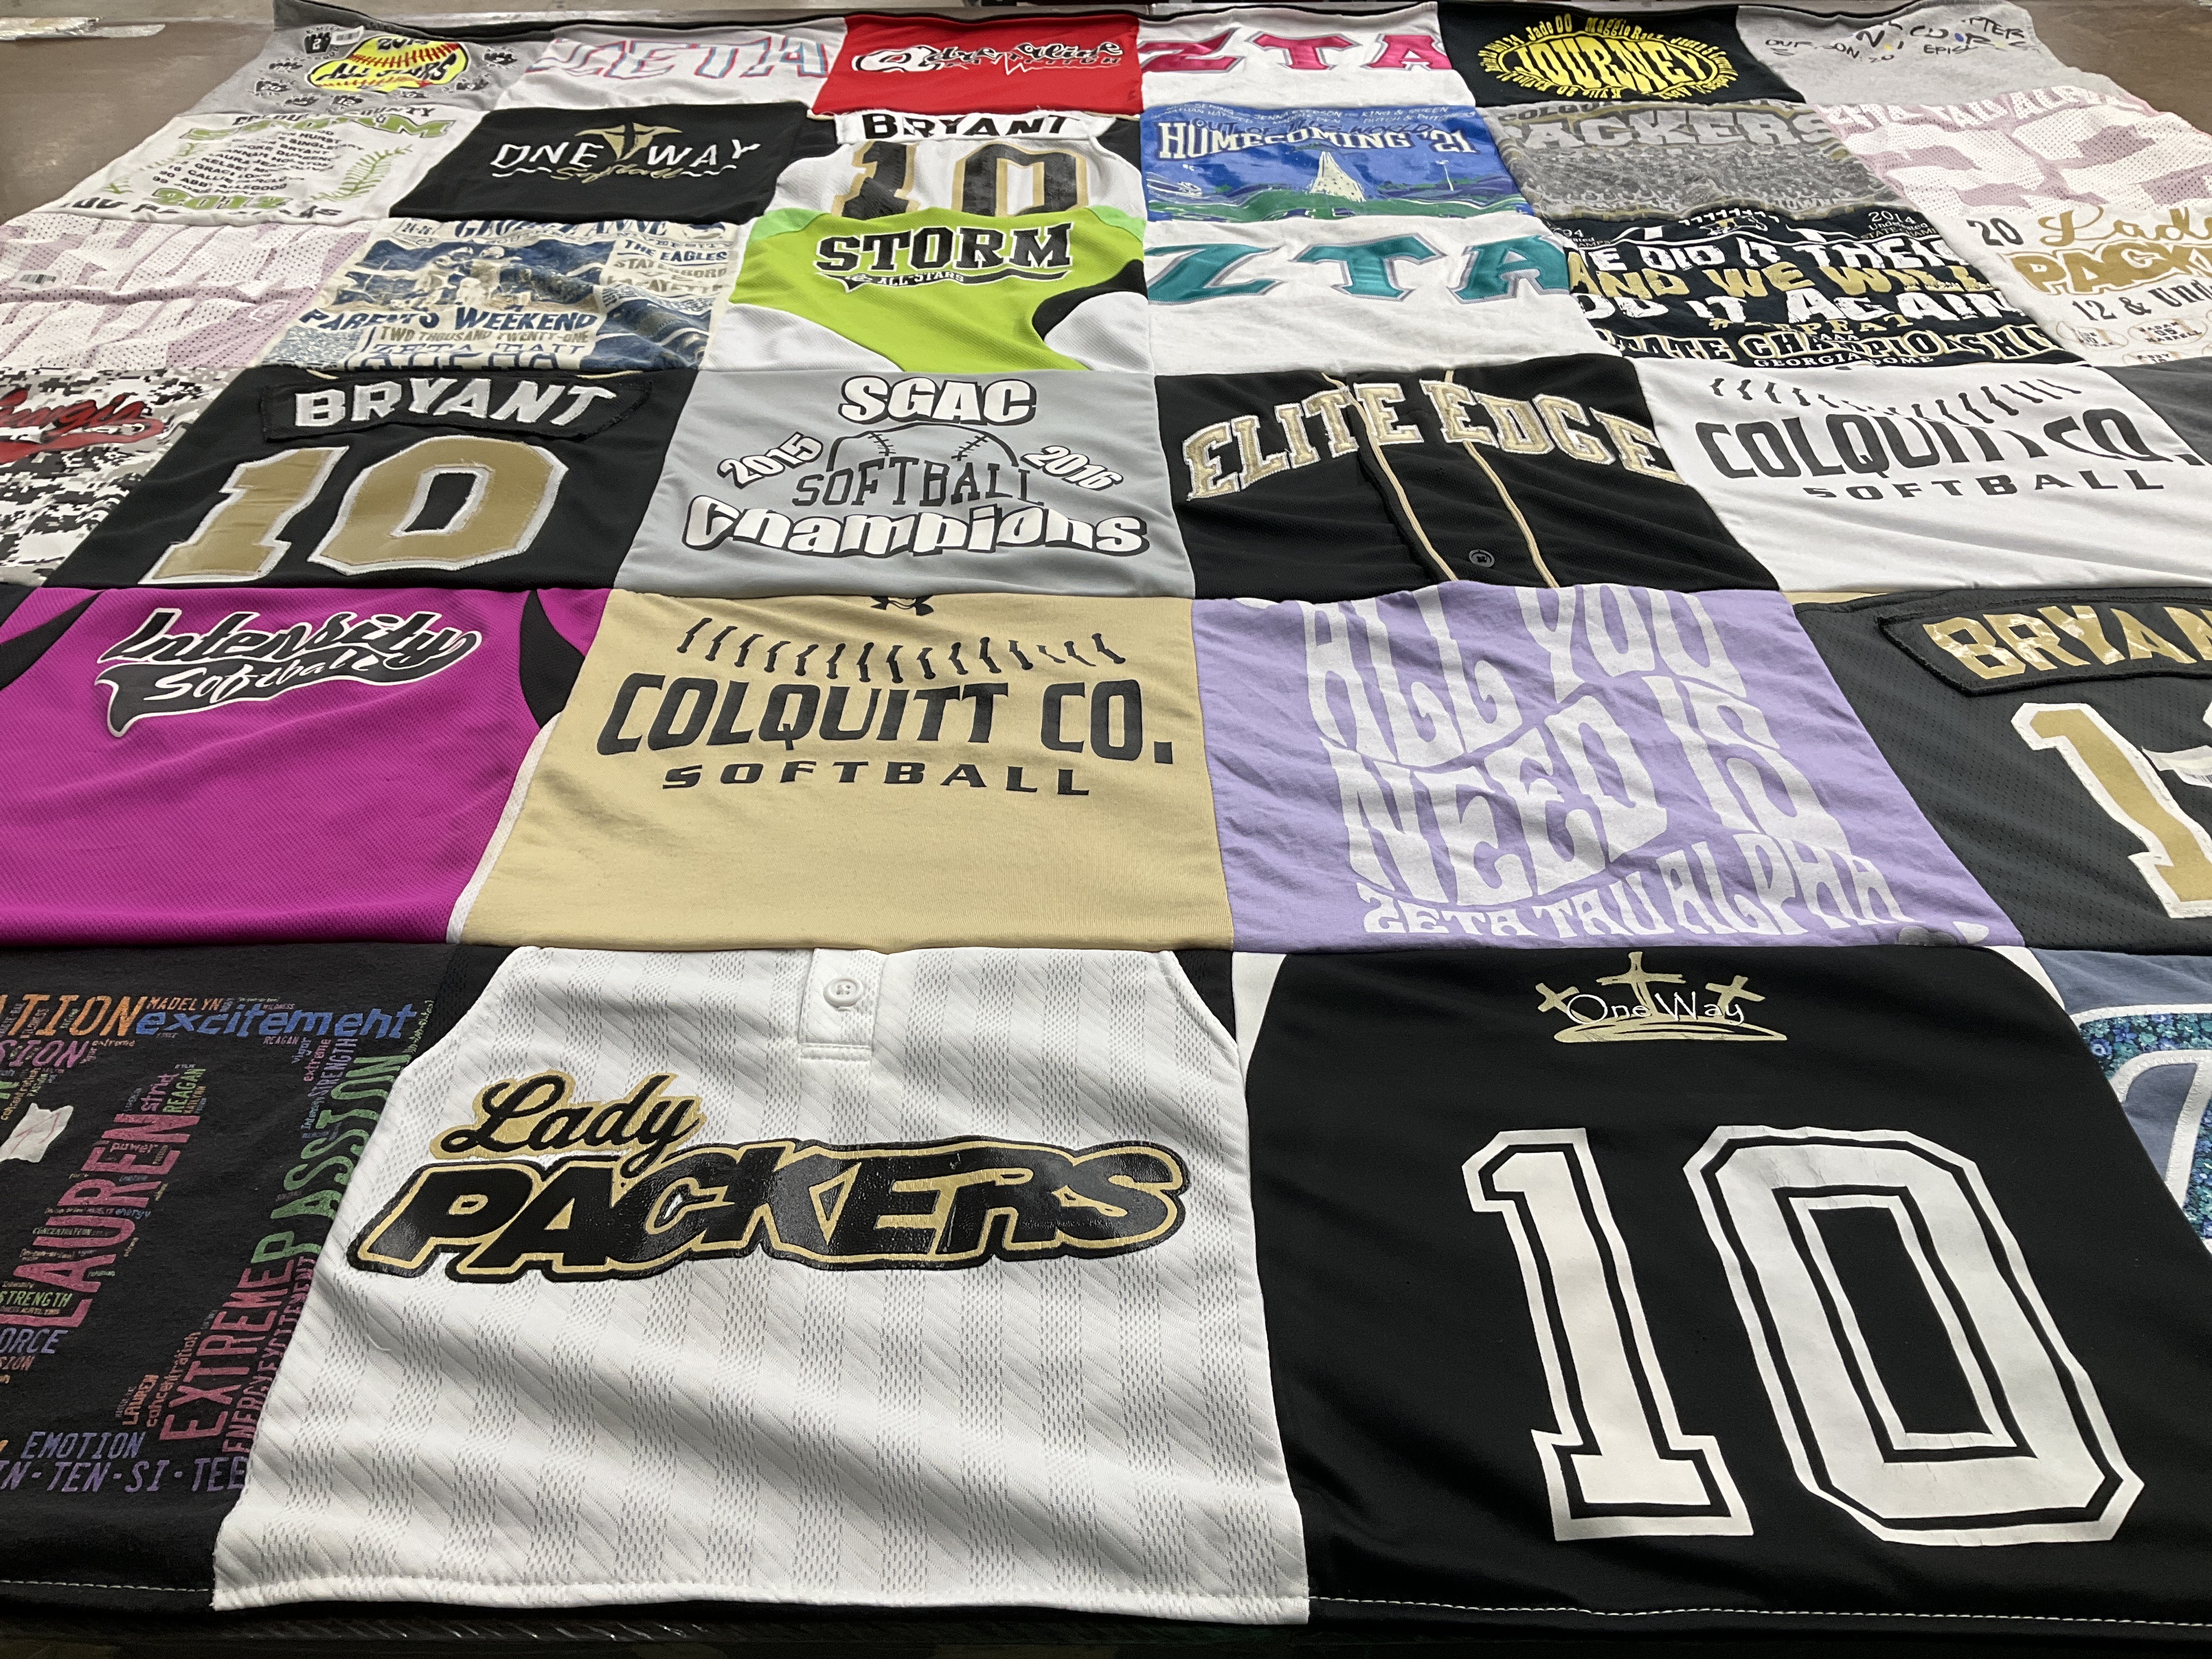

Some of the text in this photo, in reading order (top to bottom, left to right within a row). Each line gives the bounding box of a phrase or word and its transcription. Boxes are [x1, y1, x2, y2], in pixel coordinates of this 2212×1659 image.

[1525, 21, 1554, 41] Jade
[1585, 17, 1631, 36] Maggie
[1138, 27, 1452, 72] ZTA
[1514, 36, 1707, 92] JOURNEY
[862, 113, 1080, 139] BRYANT
[1159, 122, 1477, 159] HOMECOMING '21
[491, 139, 760, 168] ONE WAY
[551, 164, 684, 183] Softball
[831, 140, 1088, 218] 10
[1868, 211, 1917, 224] 2014
[1966, 217, 2024, 246] 20
[2038, 206, 2212, 247] Lad
[625, 240, 727, 262] THE EAGLES
[813, 222, 1074, 272] STORM
[1638, 245, 1725, 270] DID
[1736, 237, 1781, 267] IT
[1792, 239, 1971, 269] THEN
[877, 271, 964, 286] ALL-STARS
[1144, 233, 1570, 305] ZTA
[1568, 251, 1995, 300] AND WE WILL
[1996, 242, 2212, 295] PACK
[455, 307, 598, 331] WEEKEND
[1685, 296, 1747, 323] IT
[1785, 288, 2025, 323] AGAIN
[2072, 297, 2152, 321] 12 &
[417, 329, 492, 342] THOUSAND
[498, 330, 589, 342] TWENTY-ONE
[1754, 351, 1933, 367] GEORGIA DOME
[295, 378, 617, 427] BRYANT
[838, 376, 1037, 425] SGAC
[1183, 379, 1687, 500] ELITE EDGE
[716, 431, 1124, 490] 2015 2016
[792, 458, 1045, 506] SOFTBALL
[1803, 469, 2164, 500] SOFTBALL
[137, 436, 569, 585] 10
[684, 495, 1150, 558] Champions
[97, 608, 481, 669] Intensity
[144, 648, 379, 703] Softball
[1302, 585, 1746, 766] ALL YOU
[596, 673, 1173, 765] COLQUITT CO.
[663, 761, 1090, 796] SOFTBALL
[1321, 675, 1852, 907] NEED IS
[1357, 833, 1917, 938] ZETA TAU ALPHA
[136, 1002, 418, 1039] excitement
[146, 996, 223, 1011] MADELYN
[1567, 991, 1744, 1026] One Way
[0, 1040, 91, 1068] SION
[263, 1035, 300, 1046] REAGAN
[164, 1068, 206, 1114] REAGAN
[433, 1071, 707, 1175] Lady
[110, 1142, 158, 1154] power
[251, 1054, 411, 1263] PASSION
[0, 1114, 200, 1327] LAUREN
[347, 1137, 1190, 1283] PACKERS
[0, 1290, 72, 1307] STRENGTH
[0, 1328, 68, 1354] ORCE
[159, 1259, 294, 1441] EXTREME
[1461, 1124, 2146, 1547] 10
[21, 1431, 146, 1459] EMOTION
